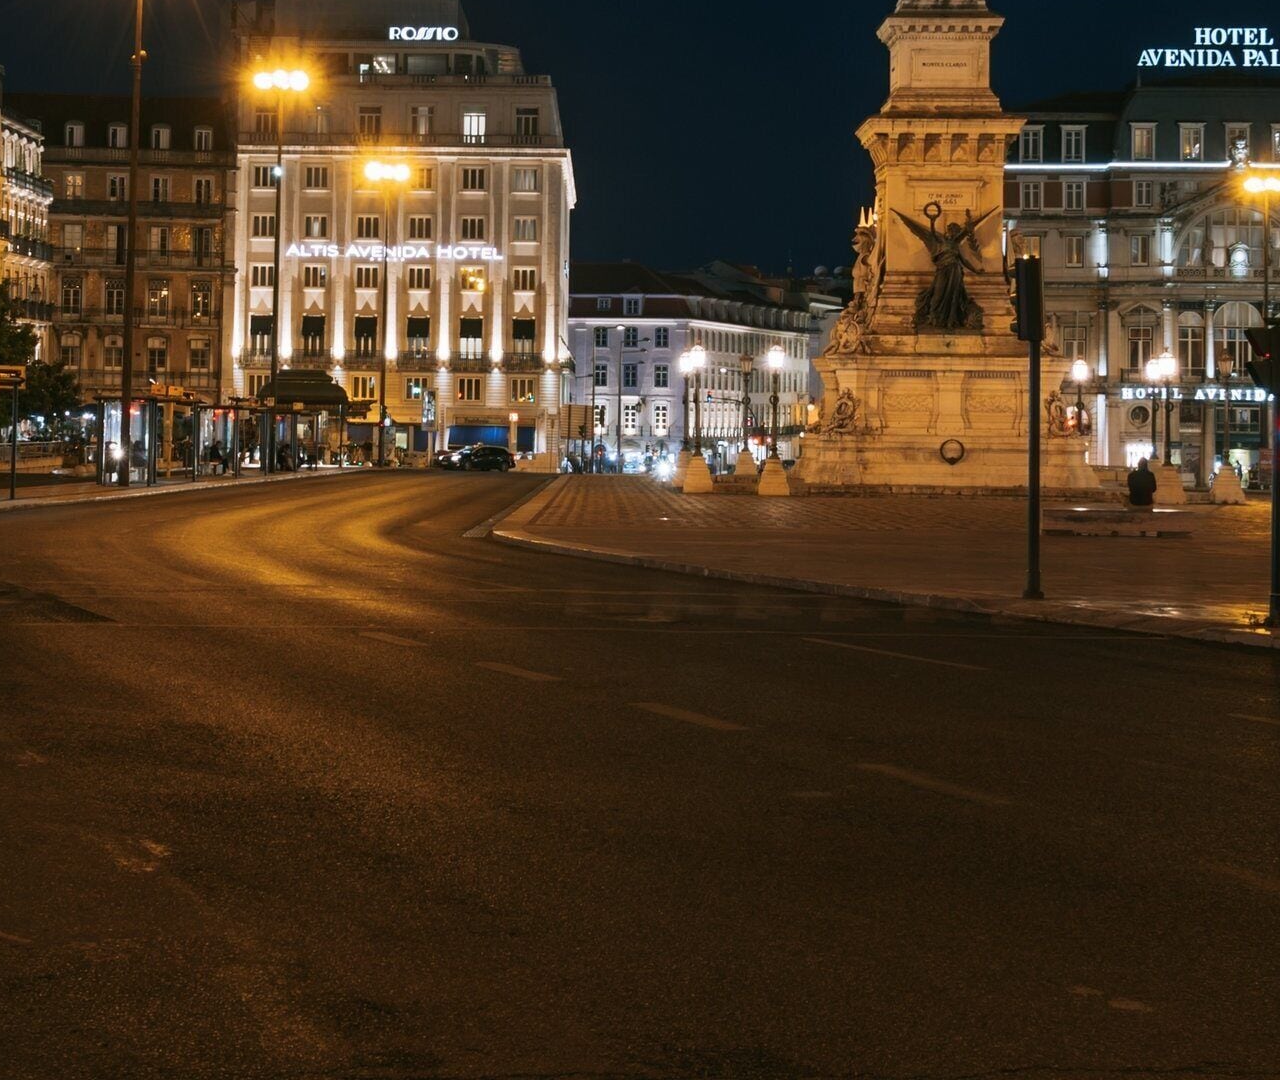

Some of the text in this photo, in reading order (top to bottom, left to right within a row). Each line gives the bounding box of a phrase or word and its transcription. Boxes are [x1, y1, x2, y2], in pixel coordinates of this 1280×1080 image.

[388, 26, 459, 41] ROSSIO
[1194, 27, 1274, 46] HOTEL
[1136, 49, 1237, 67] AVENIDA
[285, 243, 504, 261] ALTIS AVENIDA HOTEL
